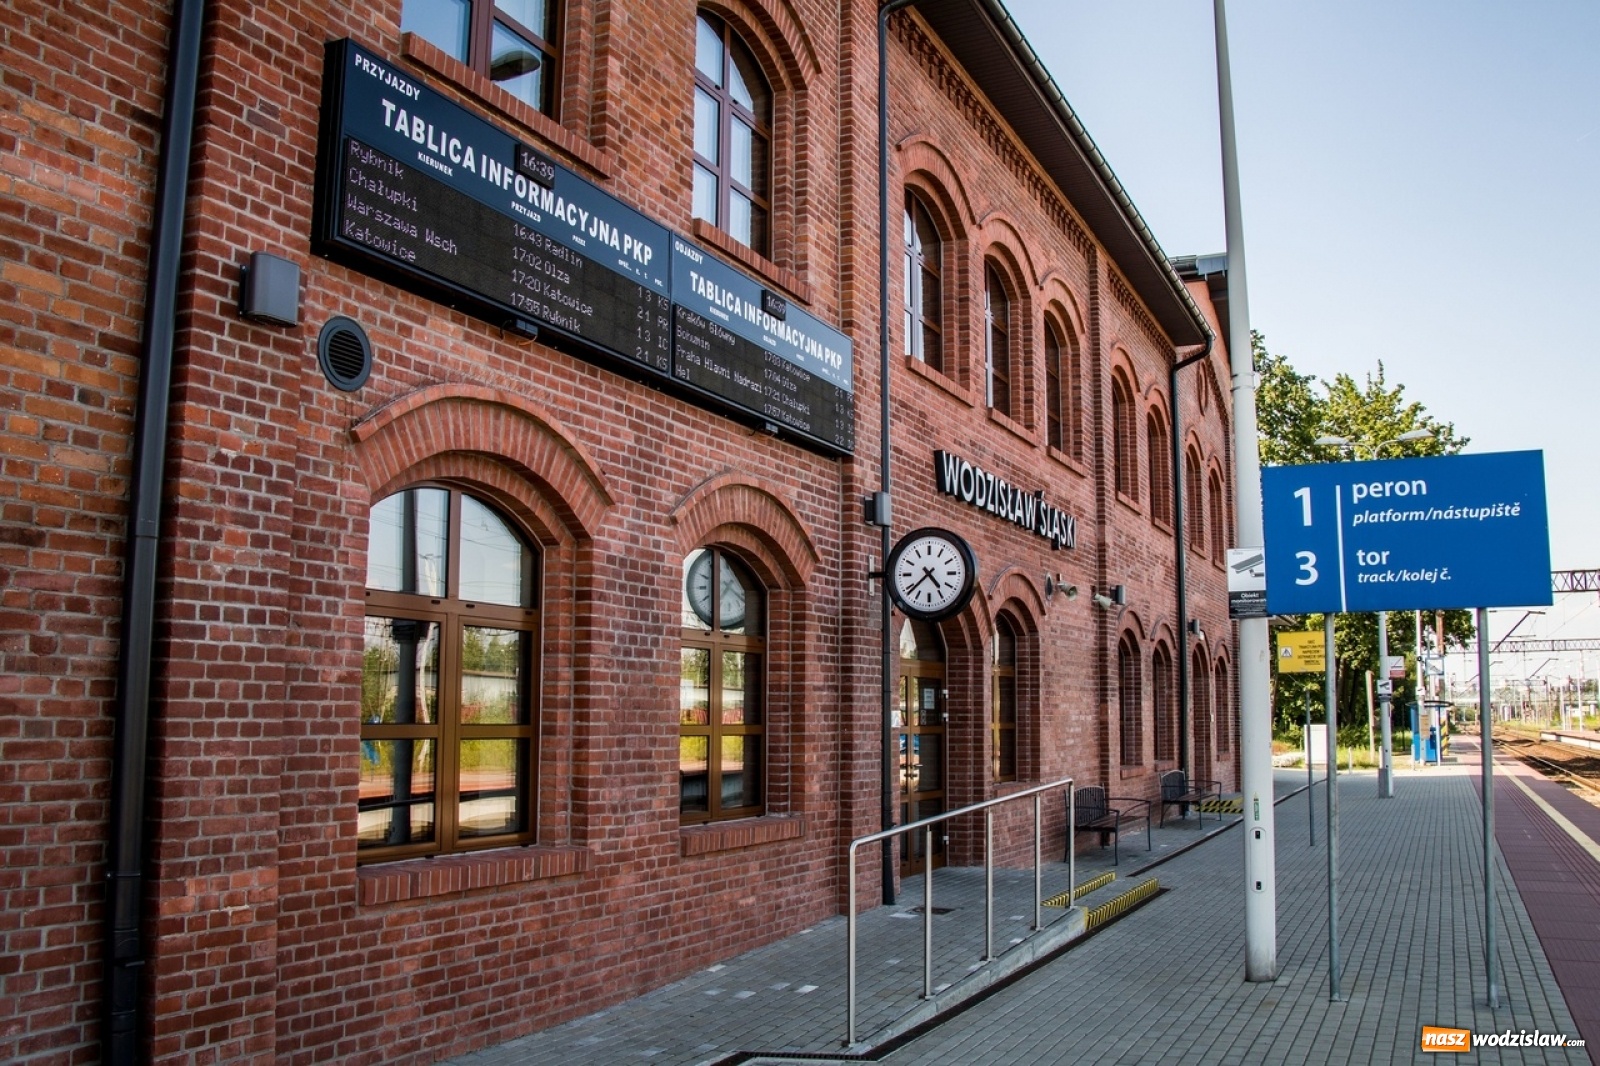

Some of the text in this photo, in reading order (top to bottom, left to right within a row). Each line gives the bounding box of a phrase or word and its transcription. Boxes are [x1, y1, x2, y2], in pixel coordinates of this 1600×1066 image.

[355, 53, 420, 100] PRZYJAZDY
[350, 141, 404, 180] Rybnik
[417, 151, 454, 177] KIERUNEK
[520, 151, 555, 181] 16:39
[349, 167, 418, 212] Chałupki
[381, 98, 653, 266] TABLICA INFORMACYJNA PKP
[344, 219, 416, 262] Katowice
[346, 193, 457, 256] Warszawa Wsch
[512, 246, 542, 271] 17:02
[513, 223, 583, 269] 16:43 Radlin
[674, 240, 703, 265] ODJAZDY
[543, 284, 594, 317] Katowice
[542, 304, 582, 334] Rybnik
[689, 270, 843, 371] TABLICA INFORMACYJNA PKP
[942, 450, 1077, 550] WODZISŁAW ŚLĄSKI
[1293, 486, 1312, 527] 1
[1352, 478, 1427, 504] peron
[1353, 501, 1521, 527] platform/nástupiště
[1294, 550, 1319, 586] 3
[1356, 550, 1390, 566] tor
[1358, 569, 1439, 584] track/kolej
